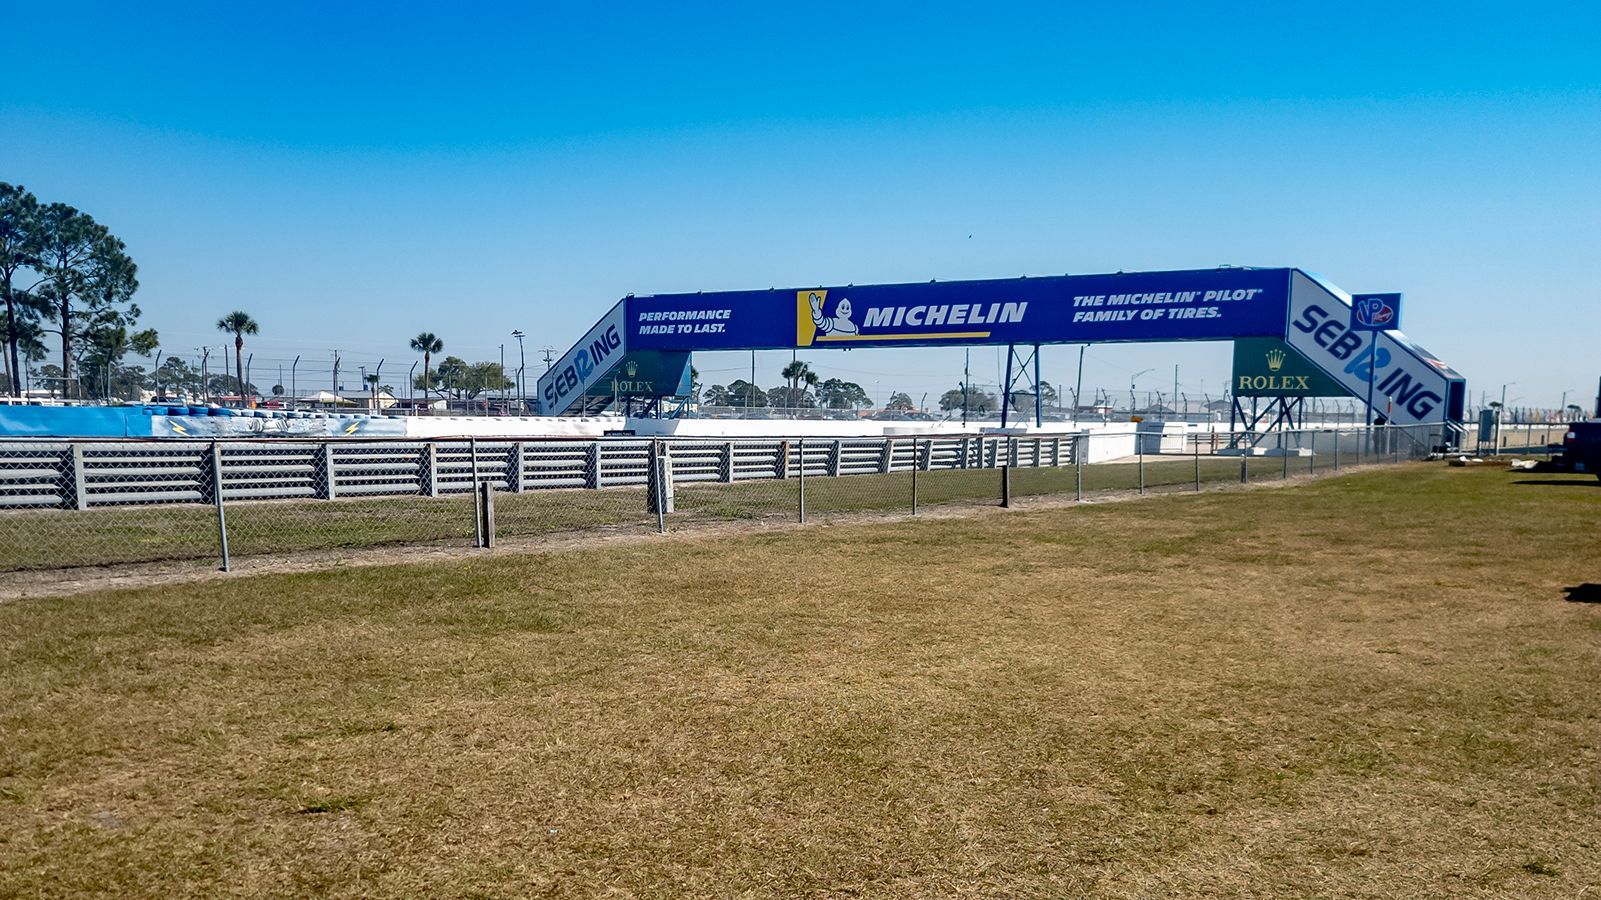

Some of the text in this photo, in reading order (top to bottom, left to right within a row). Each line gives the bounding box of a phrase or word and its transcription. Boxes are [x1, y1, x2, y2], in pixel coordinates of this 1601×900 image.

[1073, 295, 1106, 307] THE
[639, 309, 731, 321] PERFORMANCE
[863, 302, 1028, 327] MICHELIN
[1073, 306, 1222, 323] FAMILY OF TIRES.
[1357, 298, 1384, 325] VP
[639, 323, 726, 335] MADE TO LAST.
[610, 381, 654, 392] ROLEX
[1238, 375, 1310, 390] ROLEX
